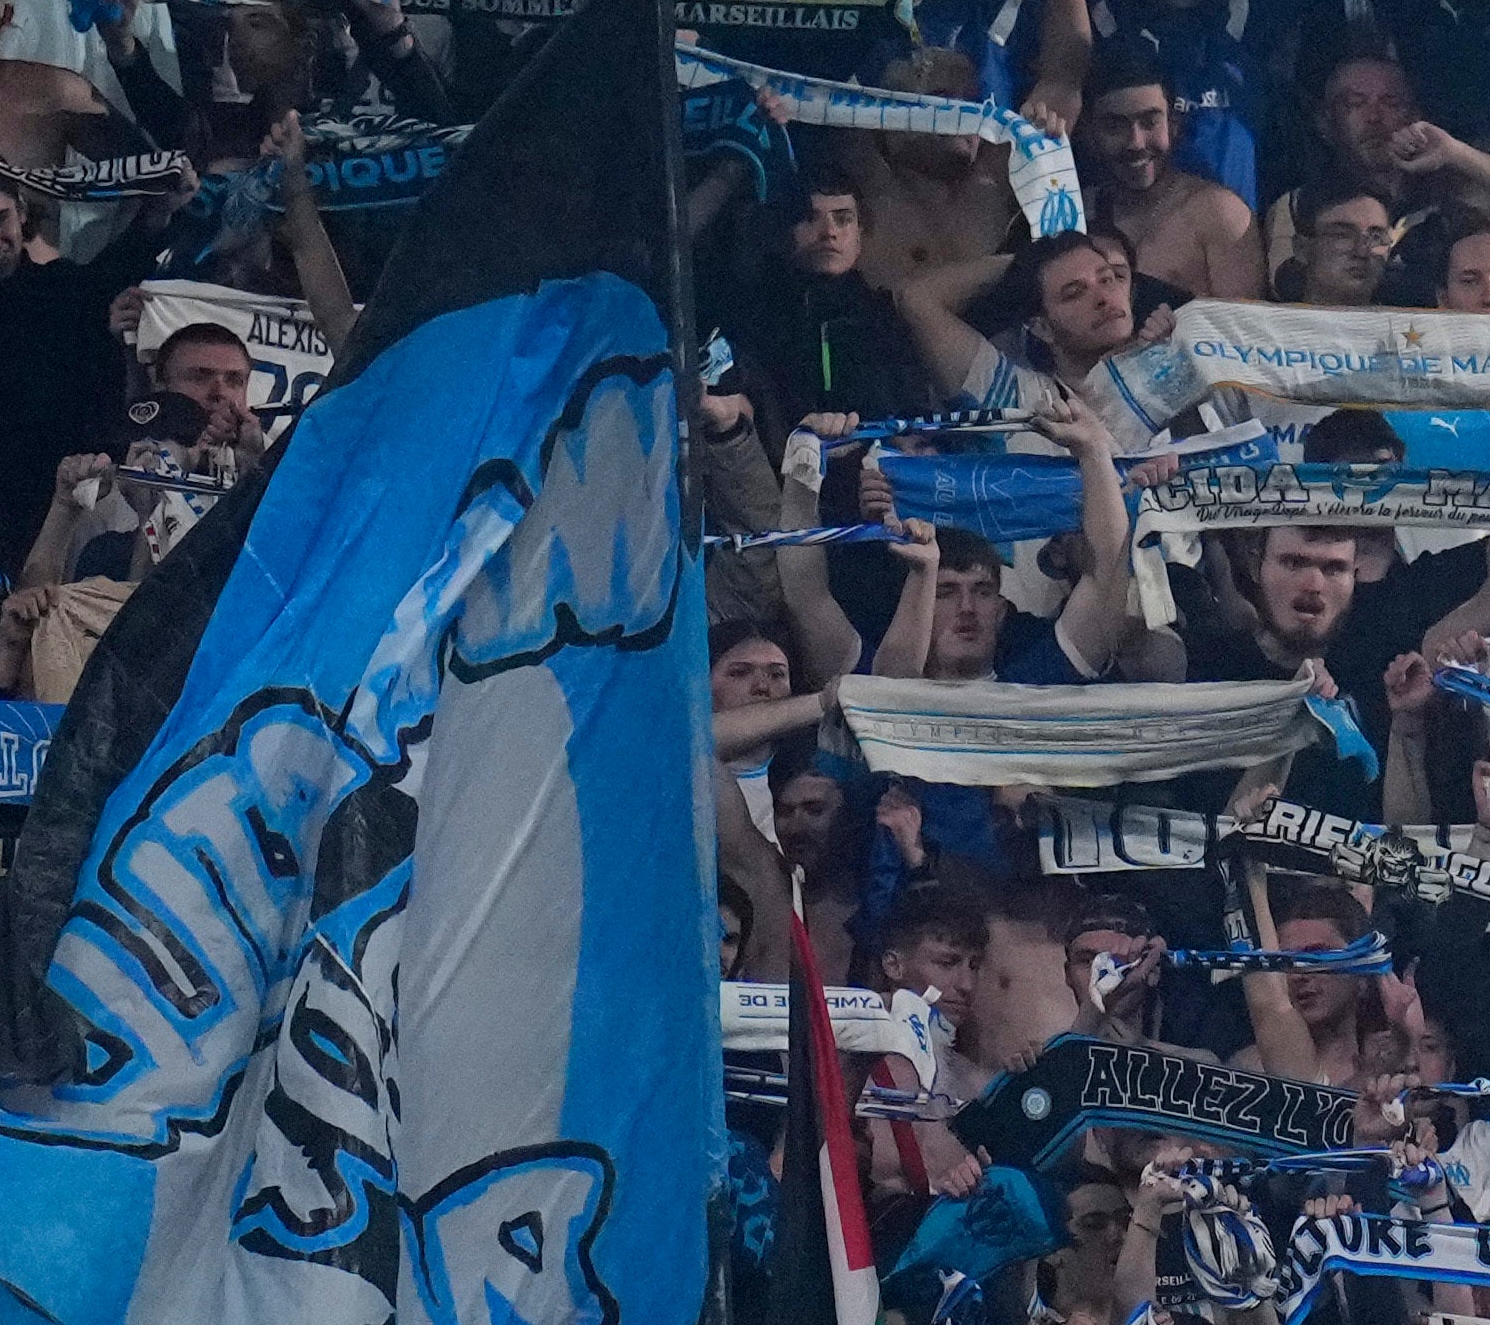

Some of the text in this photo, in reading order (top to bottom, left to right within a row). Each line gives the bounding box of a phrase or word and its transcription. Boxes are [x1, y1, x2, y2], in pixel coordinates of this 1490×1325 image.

[1195, 340, 1376, 376] OLYMPIQUE
[1400, 352, 1441, 376] DE
[1082, 1047, 1263, 1131] ALLEZ
